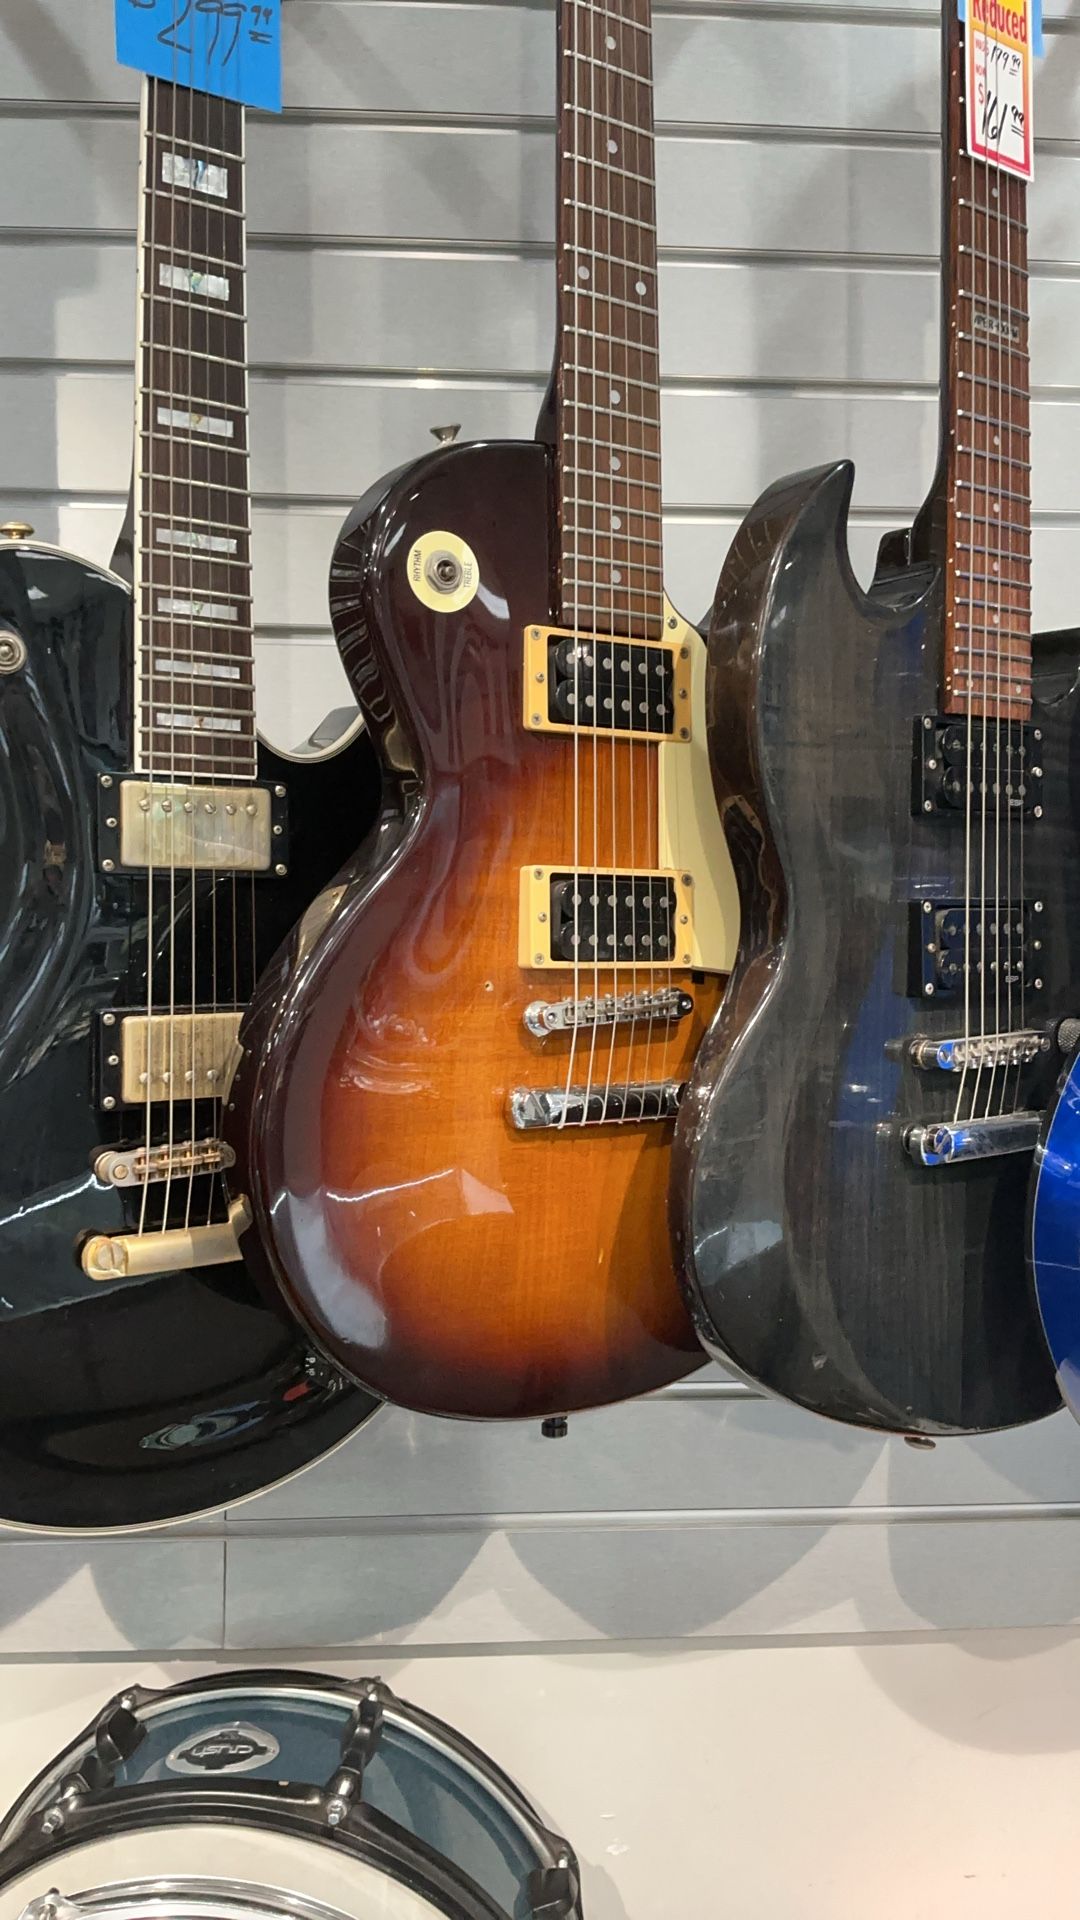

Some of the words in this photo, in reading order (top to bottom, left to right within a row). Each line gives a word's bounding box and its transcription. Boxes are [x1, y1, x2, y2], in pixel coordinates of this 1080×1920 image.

[973, 0, 1027, 43] Reduced
[412, 550, 422, 582] RHYTHM
[463, 561, 473, 588] TREBLE
